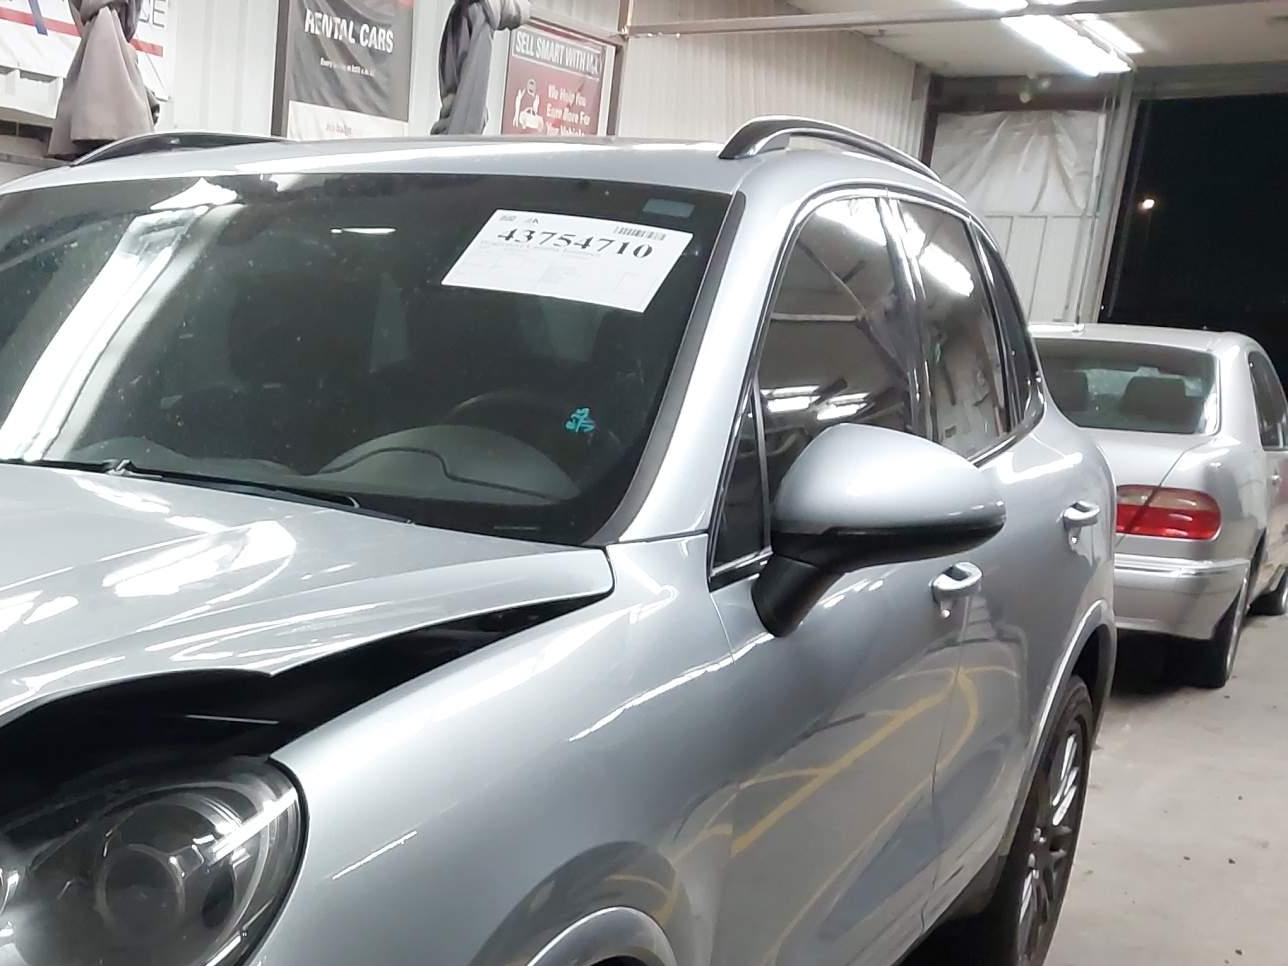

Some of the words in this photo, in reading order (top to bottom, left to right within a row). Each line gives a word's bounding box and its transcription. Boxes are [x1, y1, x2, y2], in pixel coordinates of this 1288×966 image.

[304, 8, 356, 44] RENTAL
[359, 23, 394, 53] CARS
[515, 31, 534, 57] SELL
[535, 38, 565, 65] SMART
[565, 47, 586, 72] WITH
[497, 228, 654, 259] 43754710
